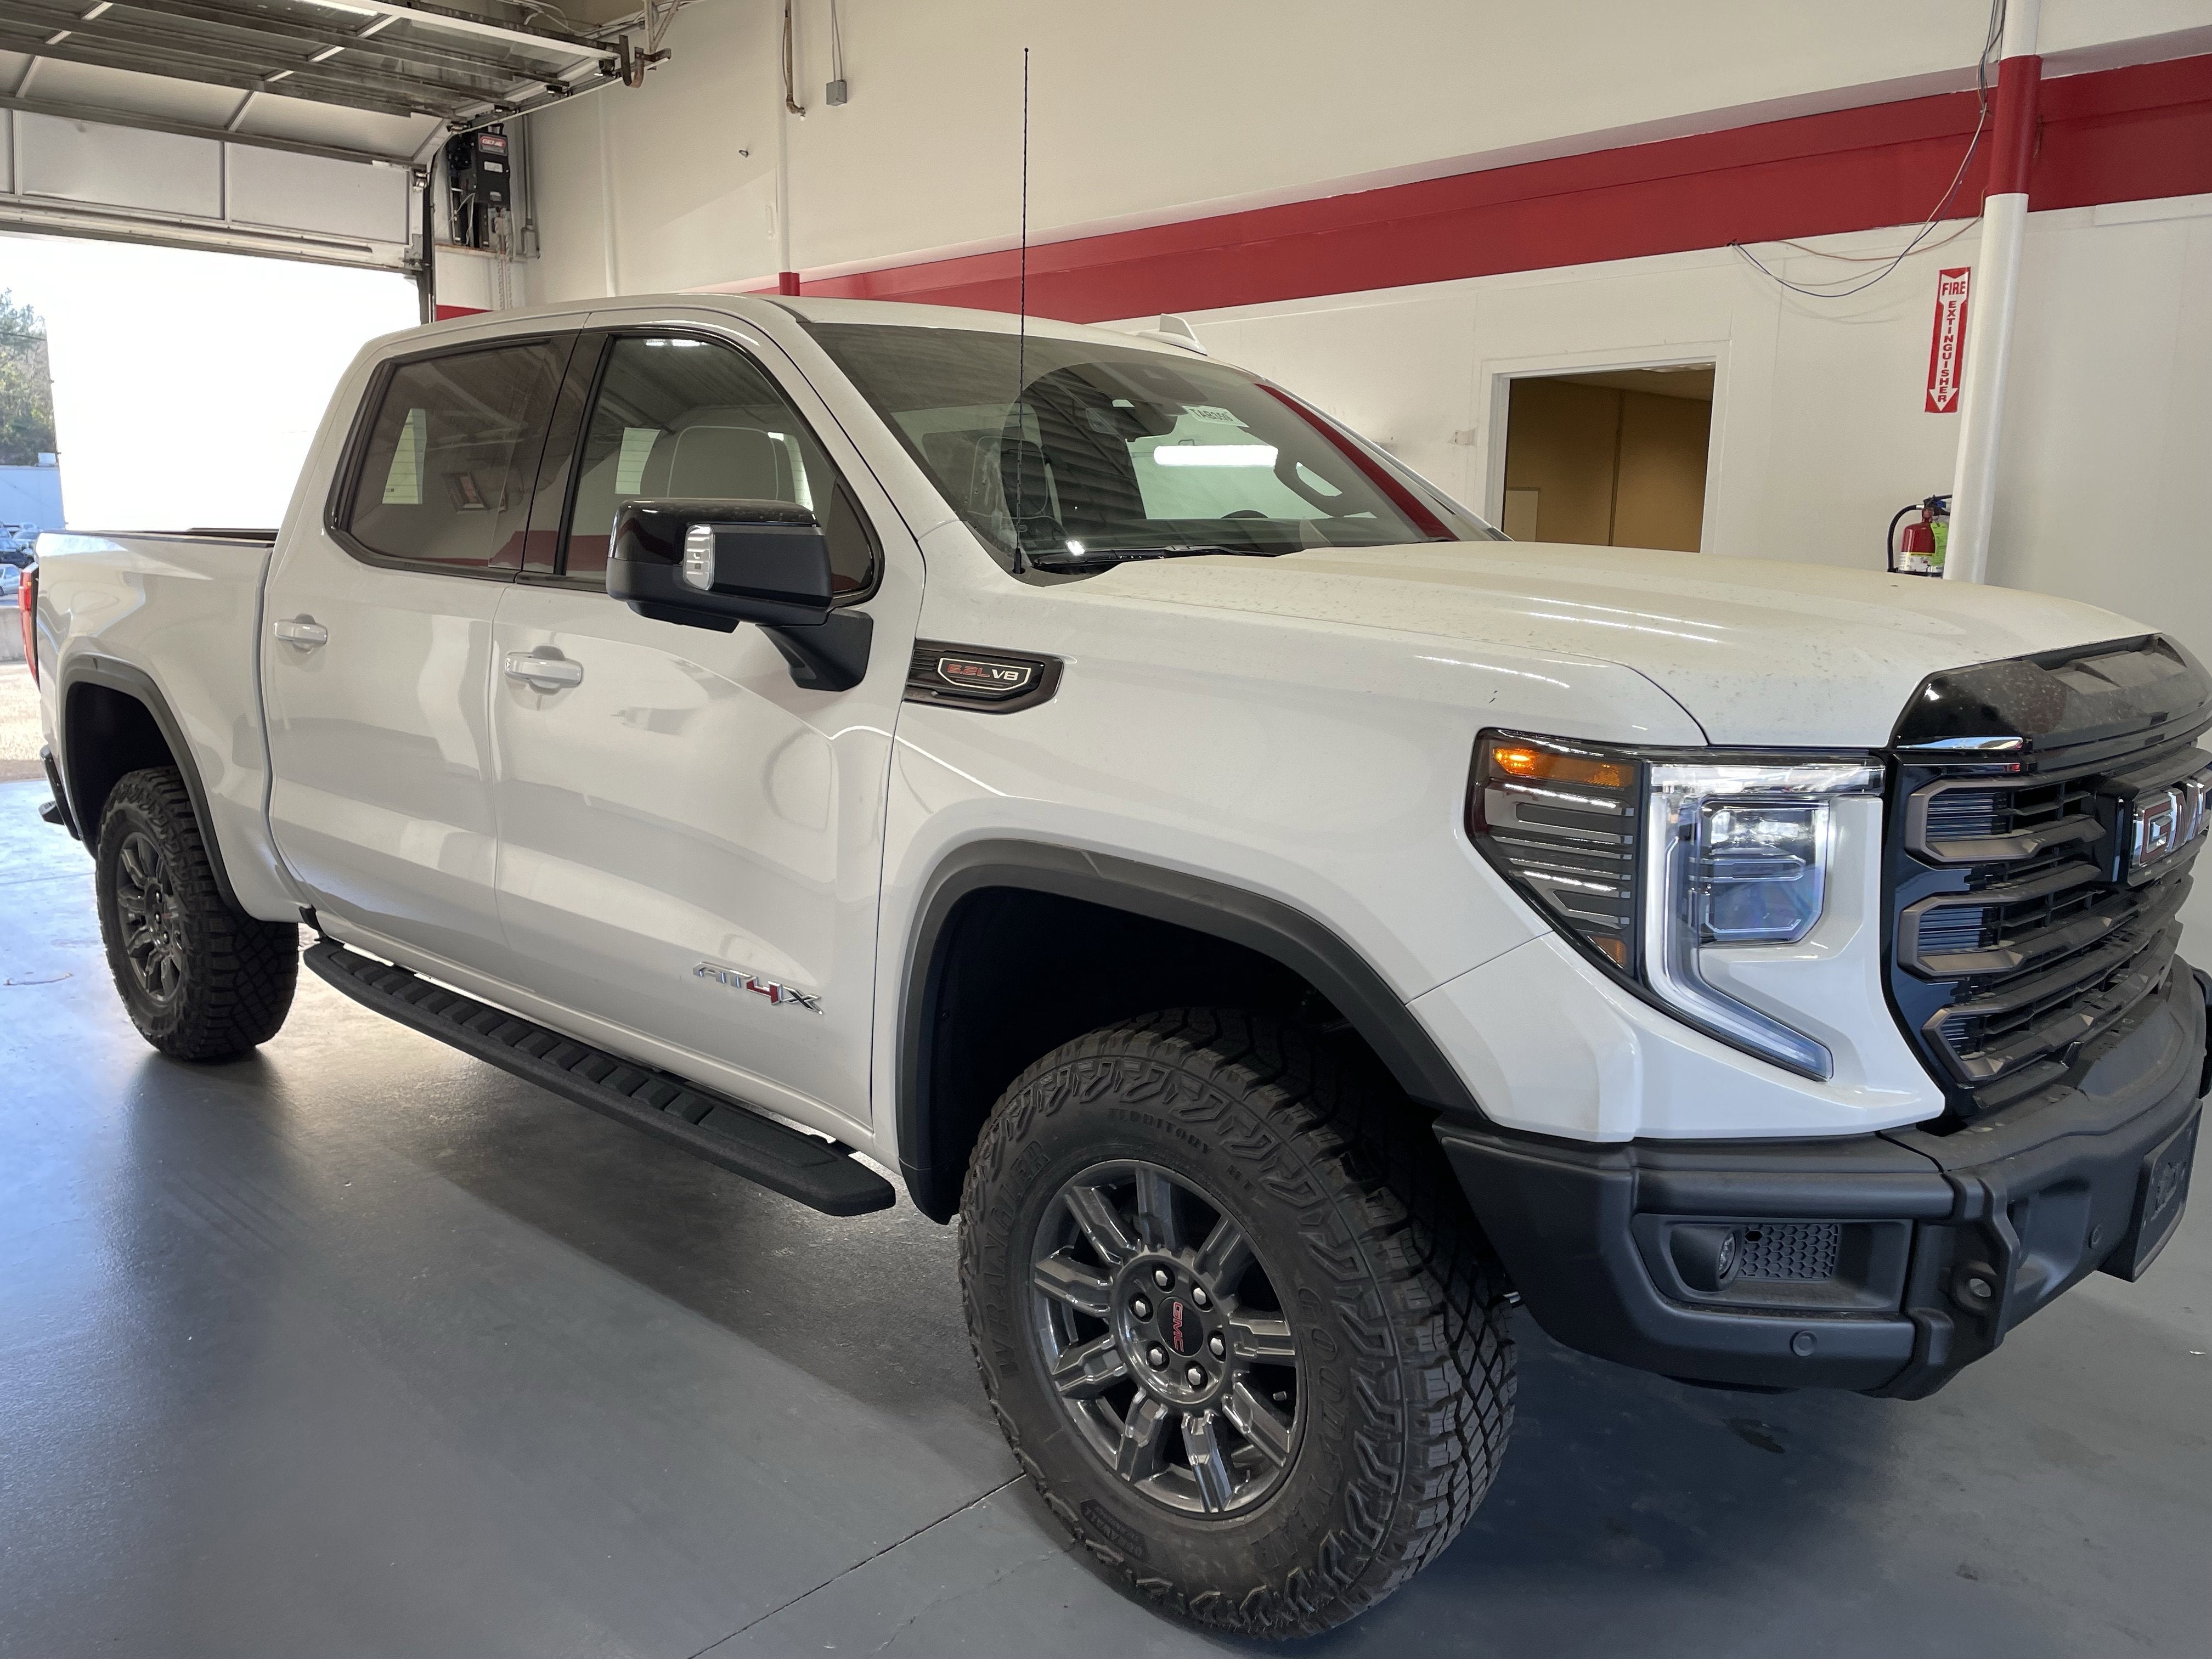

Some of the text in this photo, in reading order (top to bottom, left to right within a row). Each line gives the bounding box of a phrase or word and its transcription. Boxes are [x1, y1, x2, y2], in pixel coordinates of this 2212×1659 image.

[1942, 281, 1966, 296] FIRE
[1938, 301, 1957, 402] EXTINGUISHER
[947, 664, 1019, 681] 6.2L V8
[693, 962, 824, 1015] AT4X
[1108, 1108, 1215, 1154] TERRITORY
[983, 1139, 1051, 1378] WRANGLER
[1173, 1302, 1184, 1352] GMC
